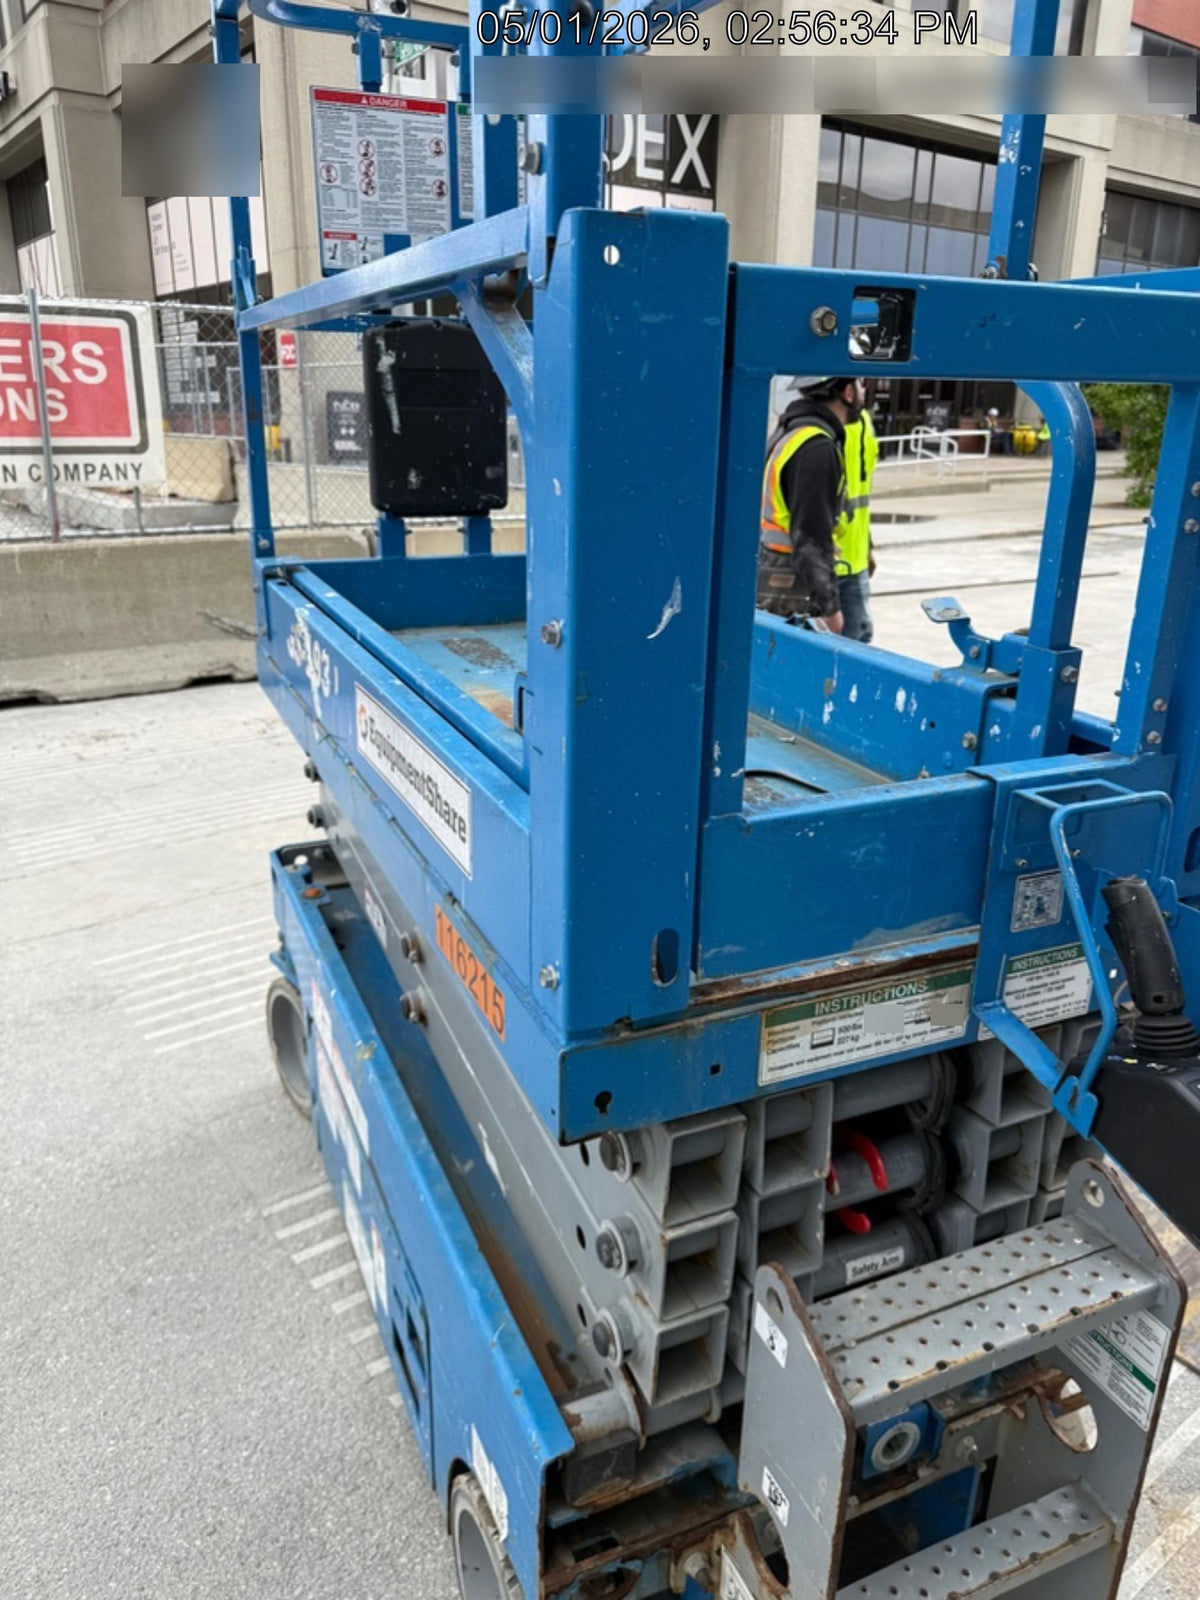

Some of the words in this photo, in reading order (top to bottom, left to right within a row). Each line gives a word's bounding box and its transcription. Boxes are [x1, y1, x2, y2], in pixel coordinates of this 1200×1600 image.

[0, 387, 69, 422] NS
[369, 717, 467, 844] EquipmentShare
[435, 909, 506, 1036] 116215
[813, 980, 929, 1017] INSTRUCTIONS
[851, 1262, 879, 1278] Safety
